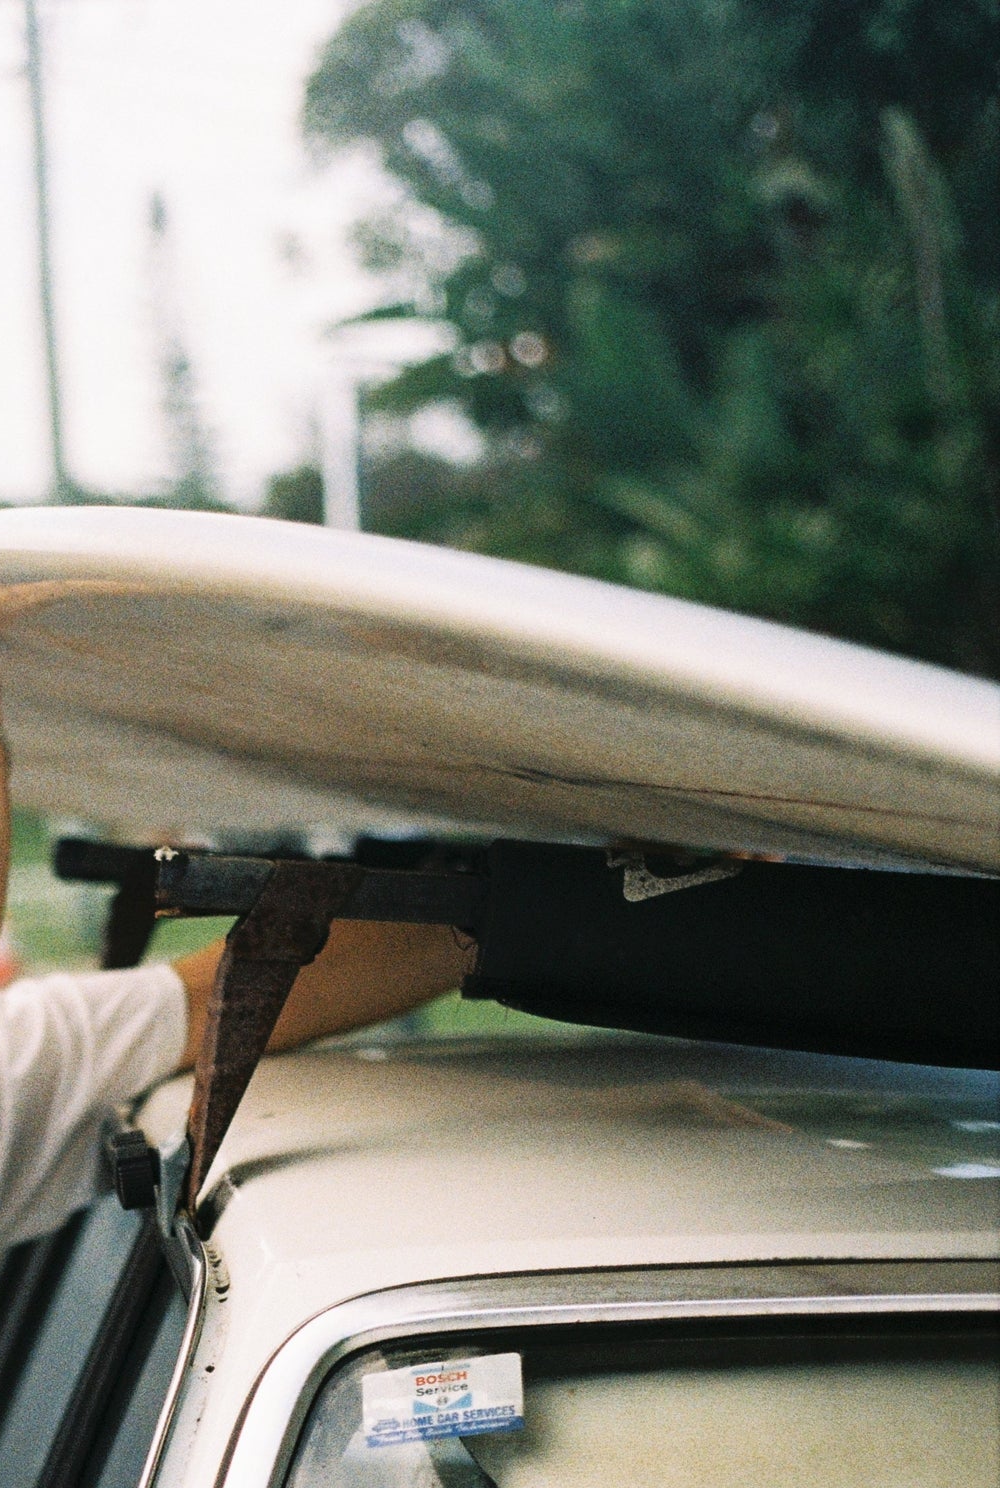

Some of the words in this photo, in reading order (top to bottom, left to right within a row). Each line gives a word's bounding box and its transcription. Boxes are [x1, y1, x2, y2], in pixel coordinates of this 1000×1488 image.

[415, 1371, 468, 1386] BOSCH
[416, 1383, 469, 1397] Service
[437, 1411, 460, 1423] CAR
[463, 1405, 516, 1421] SERVICES
